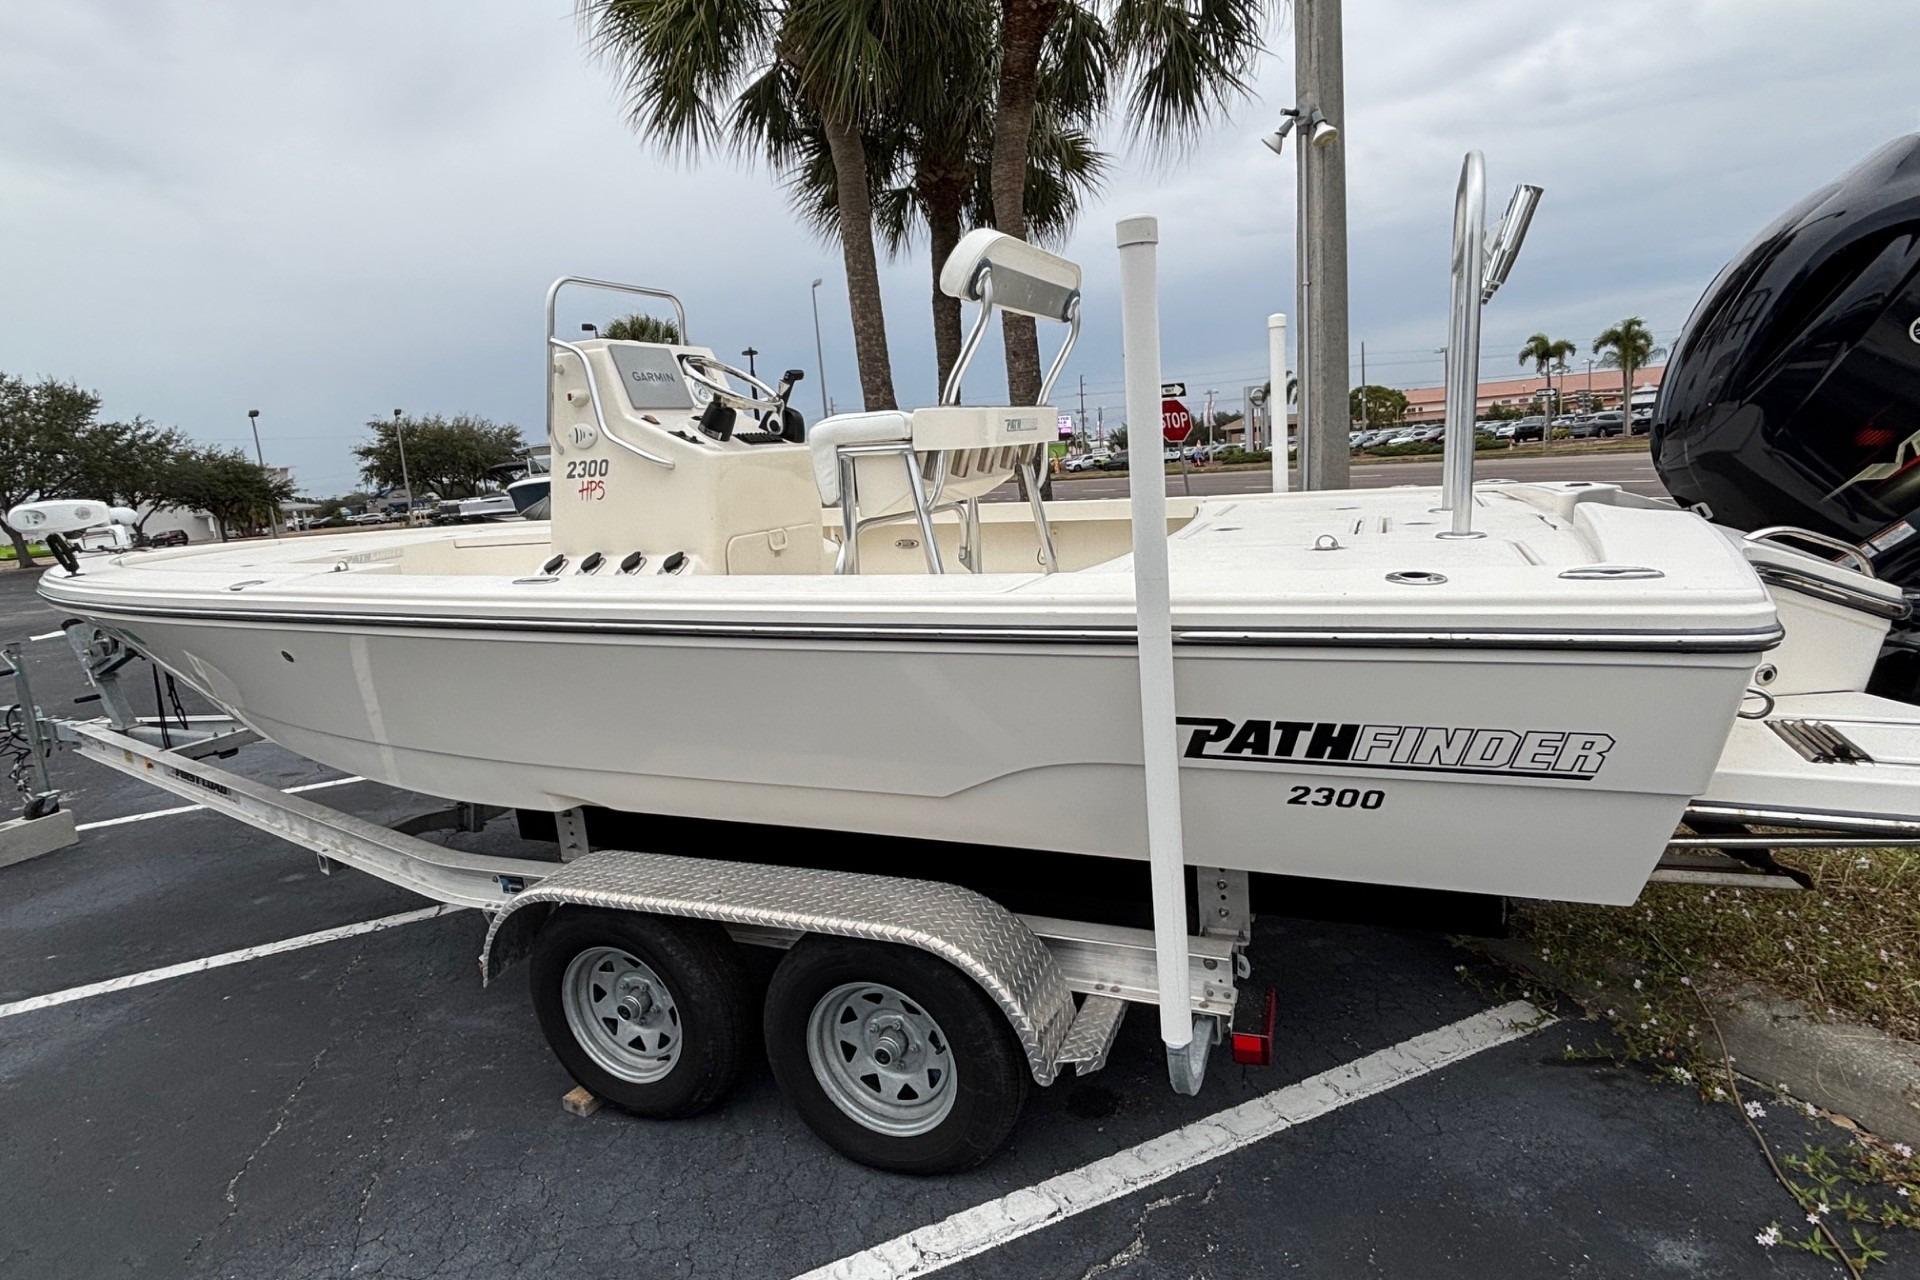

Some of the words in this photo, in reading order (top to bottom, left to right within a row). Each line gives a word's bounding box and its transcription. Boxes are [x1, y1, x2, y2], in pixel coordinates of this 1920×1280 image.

[632, 371, 675, 382] GARMIN
[566, 459, 609, 479] 2300
[578, 480, 606, 501] HPS
[1176, 716, 1616, 777] PATHFINDER
[1287, 785, 1386, 810] 2300
